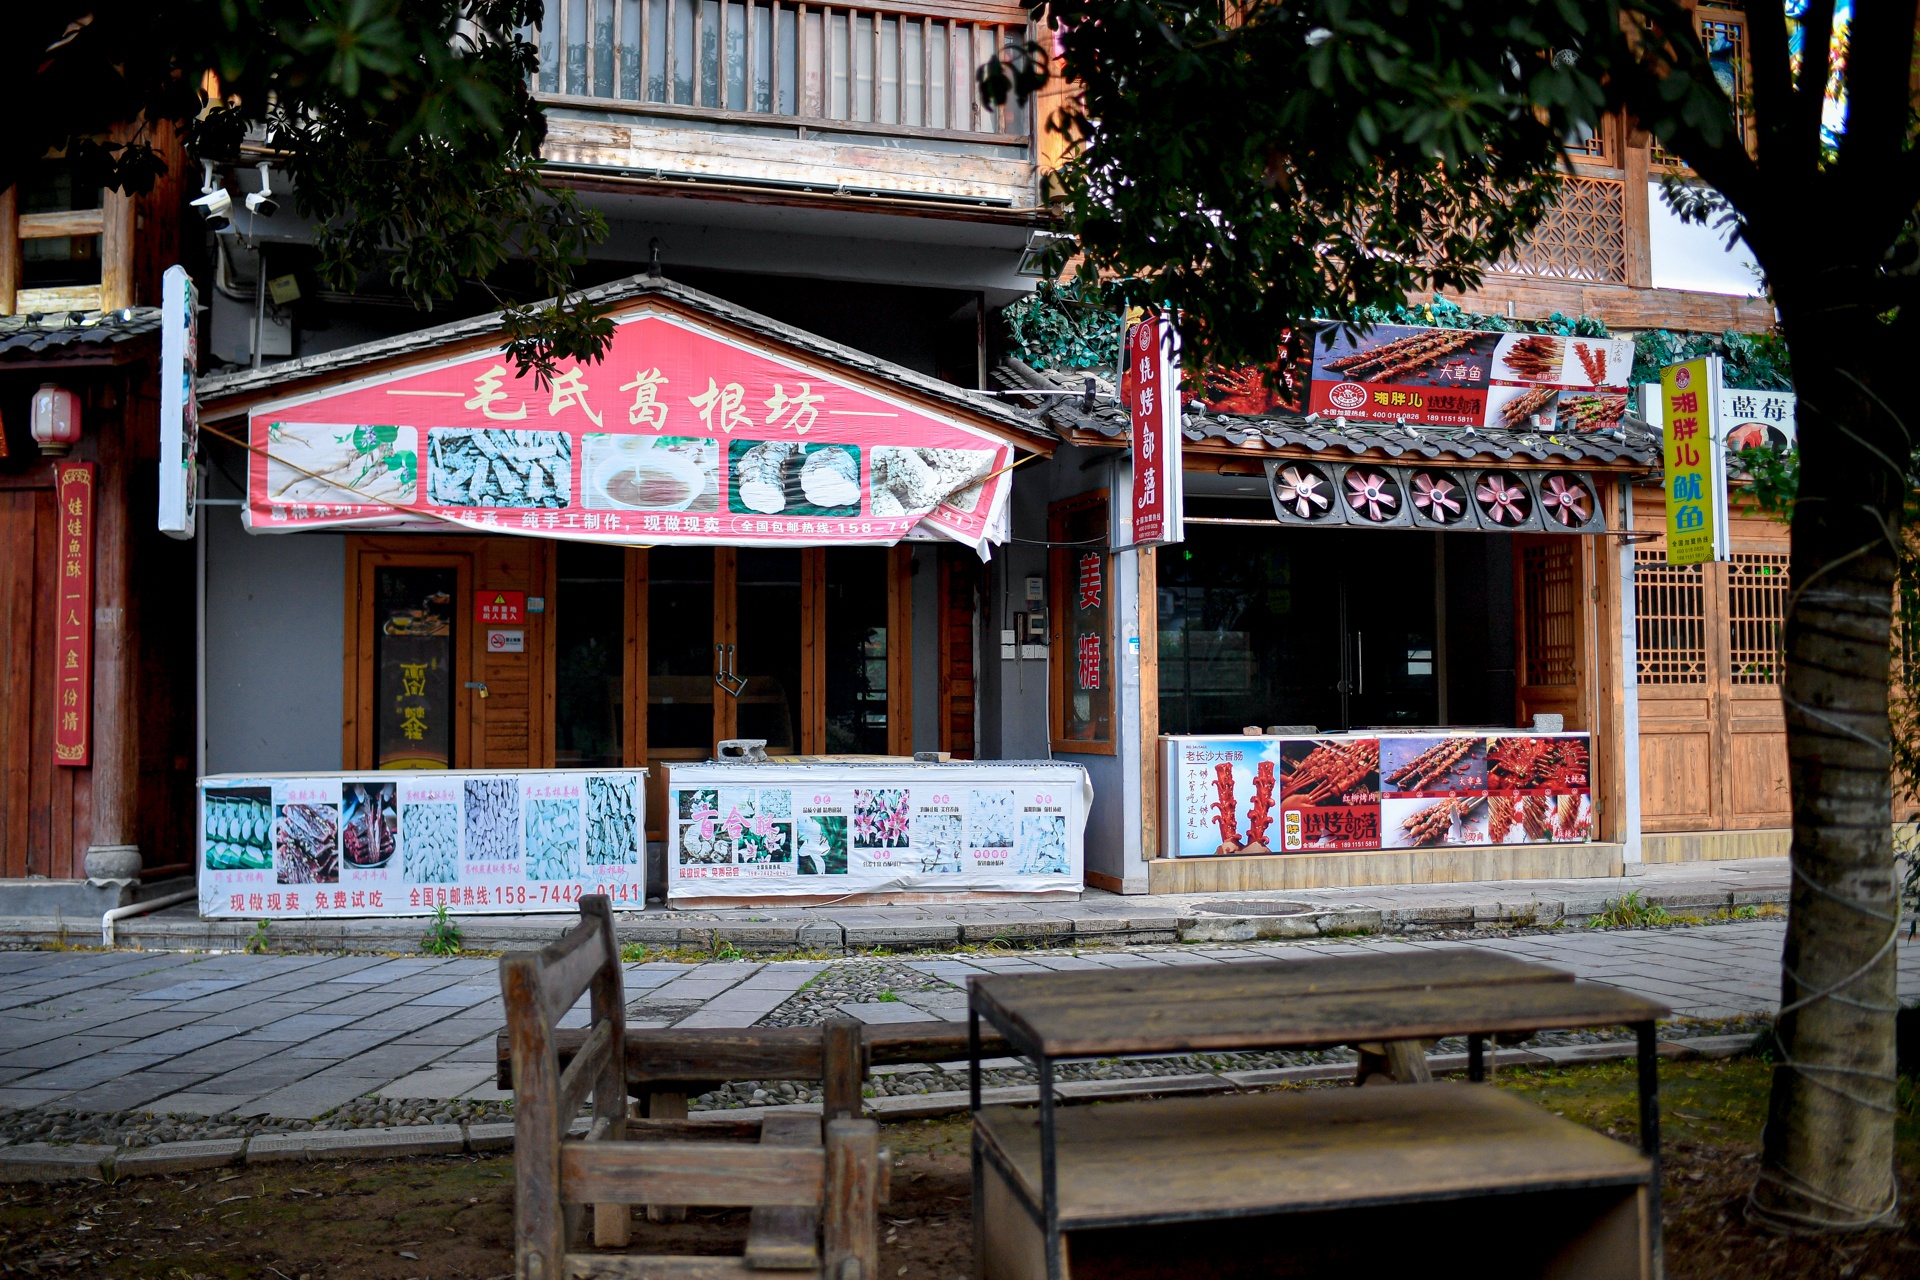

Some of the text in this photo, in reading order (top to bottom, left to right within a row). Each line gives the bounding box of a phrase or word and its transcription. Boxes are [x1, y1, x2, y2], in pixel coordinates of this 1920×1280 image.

[1439, 364, 1482, 381] 大章鱼
[465, 364, 824, 434] 毛氏葛根坊
[1373, 391, 1423, 408] 湘胖儿
[1139, 356, 1155, 509] 烧烤部落
[1079, 552, 1101, 690] 姜糖
[1186, 751, 1243, 761] 老长沙大香肠
[692, 806, 777, 841] 百合酥
[230, 892, 299, 911] 现做现卖
[315, 890, 384, 910] 免费试吃
